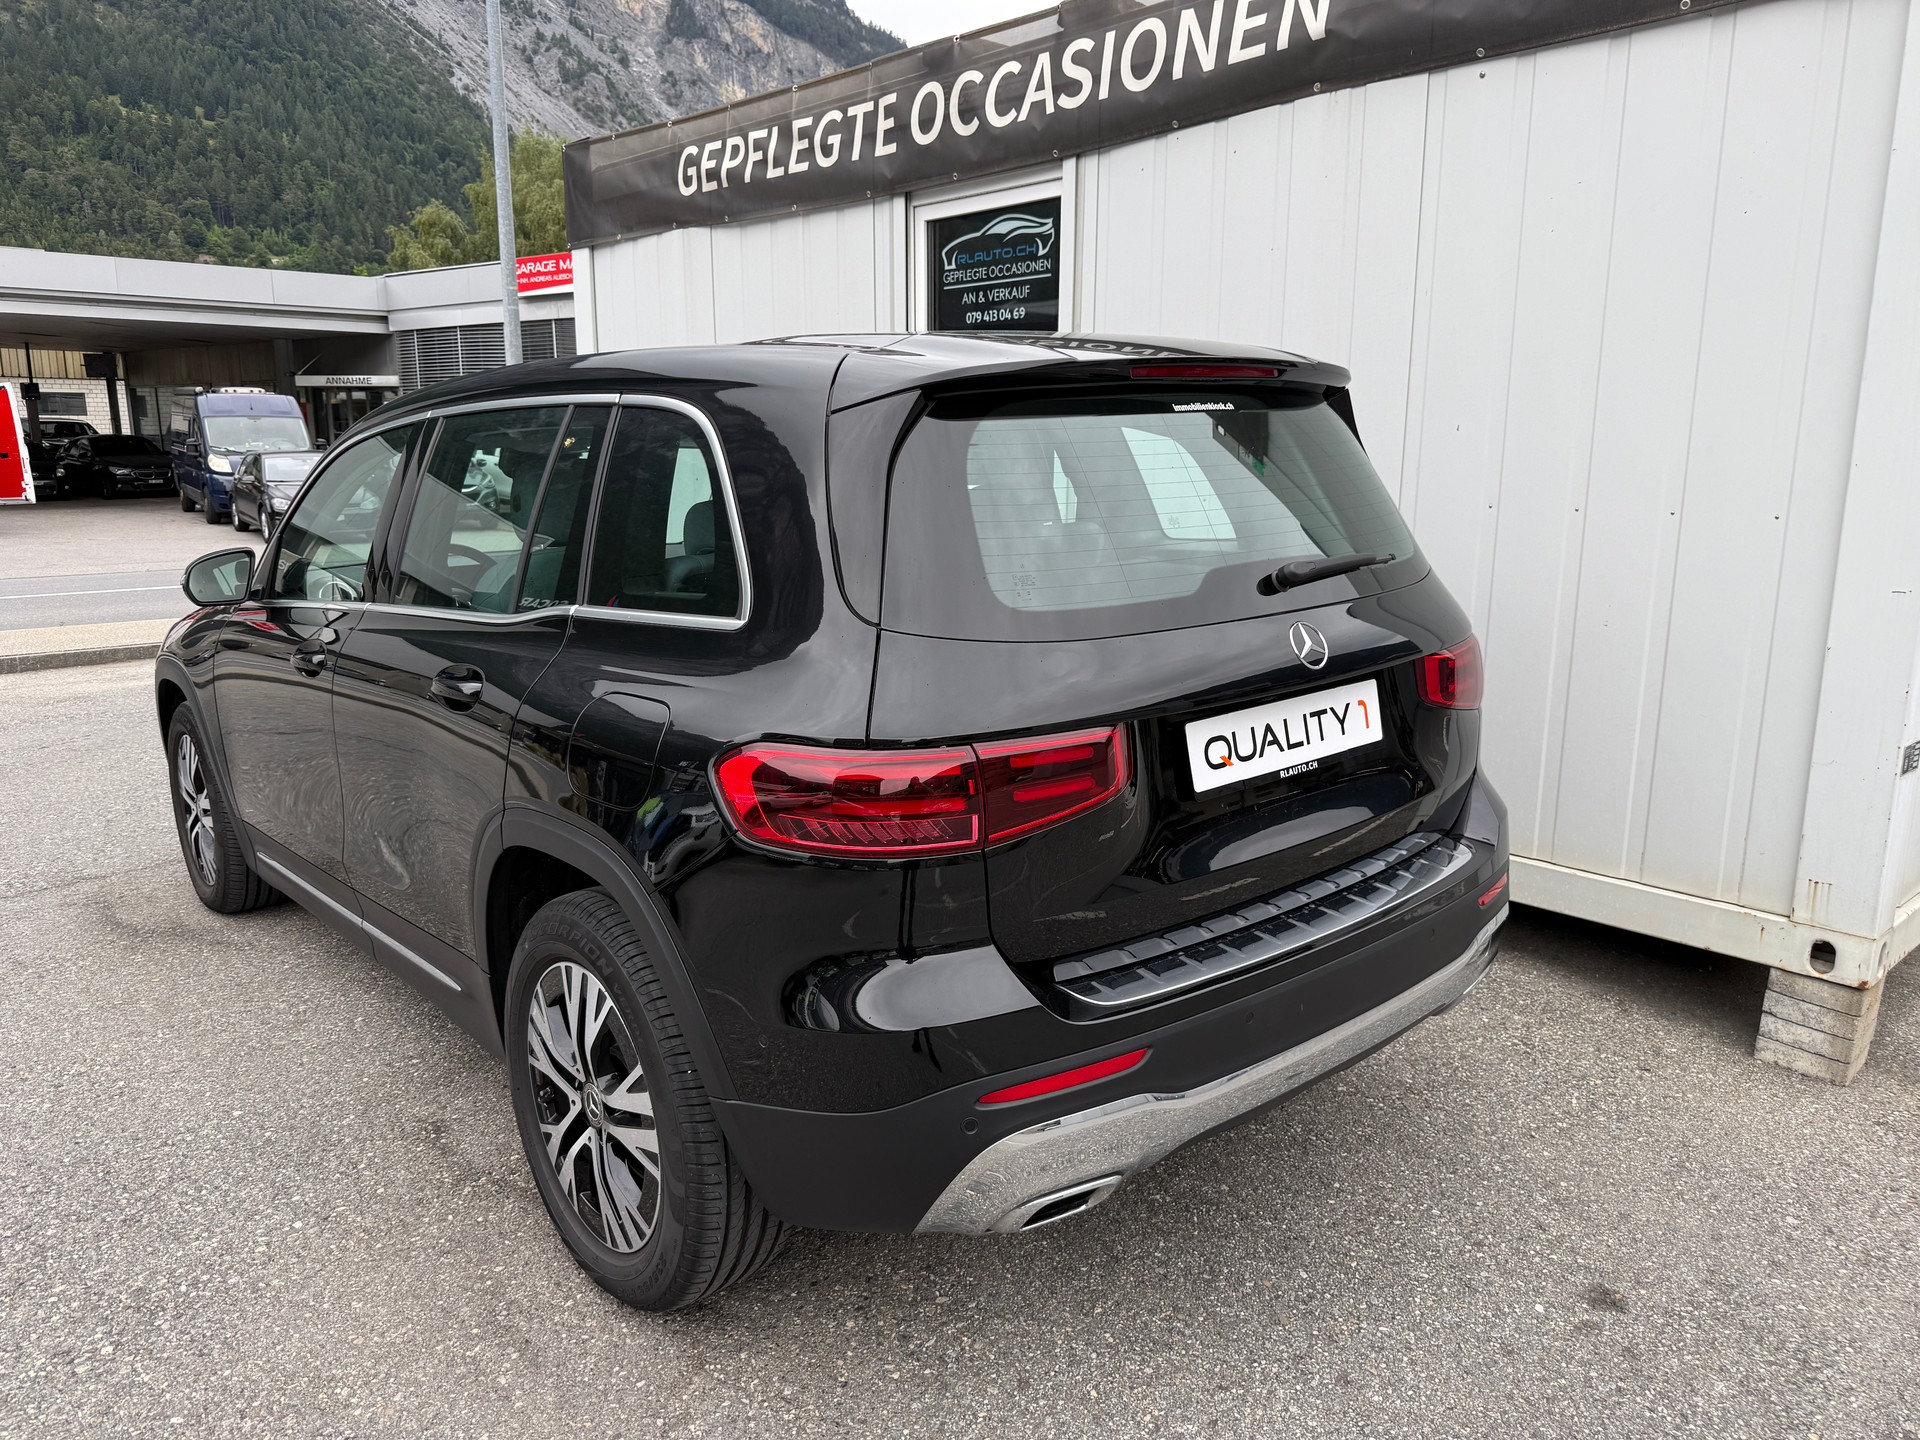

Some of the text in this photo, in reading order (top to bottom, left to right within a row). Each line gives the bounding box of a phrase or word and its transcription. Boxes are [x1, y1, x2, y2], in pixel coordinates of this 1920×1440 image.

[676, 0, 1332, 197] GEPFLEGTE OCCASIONEN
[957, 243, 1037, 264] RLAUTO.CH
[516, 260, 556, 274] GARAGE
[943, 258, 1052, 284] GEPFLEGTE OCCASIONEN
[961, 285, 1031, 305] AN & VERKAUF
[965, 307, 1026, 324] 079 413 04 69
[326, 377, 373, 385] ANNAHME
[1203, 702, 1351, 770] QUALITY
[1279, 760, 1319, 779] RLAUTO.CH
